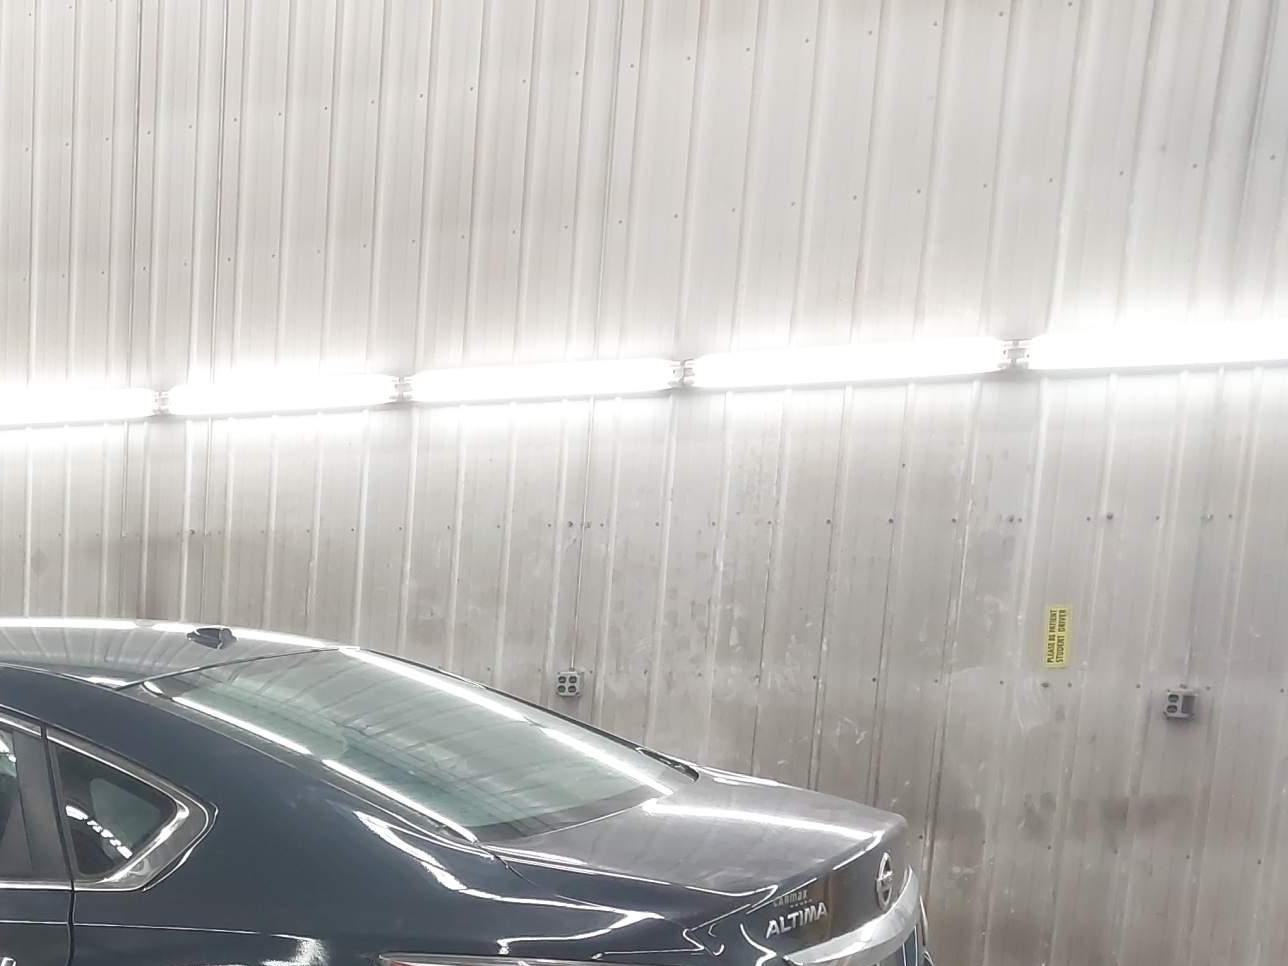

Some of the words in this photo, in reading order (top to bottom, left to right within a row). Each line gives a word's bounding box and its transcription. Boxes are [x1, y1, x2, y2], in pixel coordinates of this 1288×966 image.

[1058, 609, 1067, 632] DRIVER
[1056, 635, 1064, 663] STUDENT
[765, 902, 828, 939] ALTIMA
